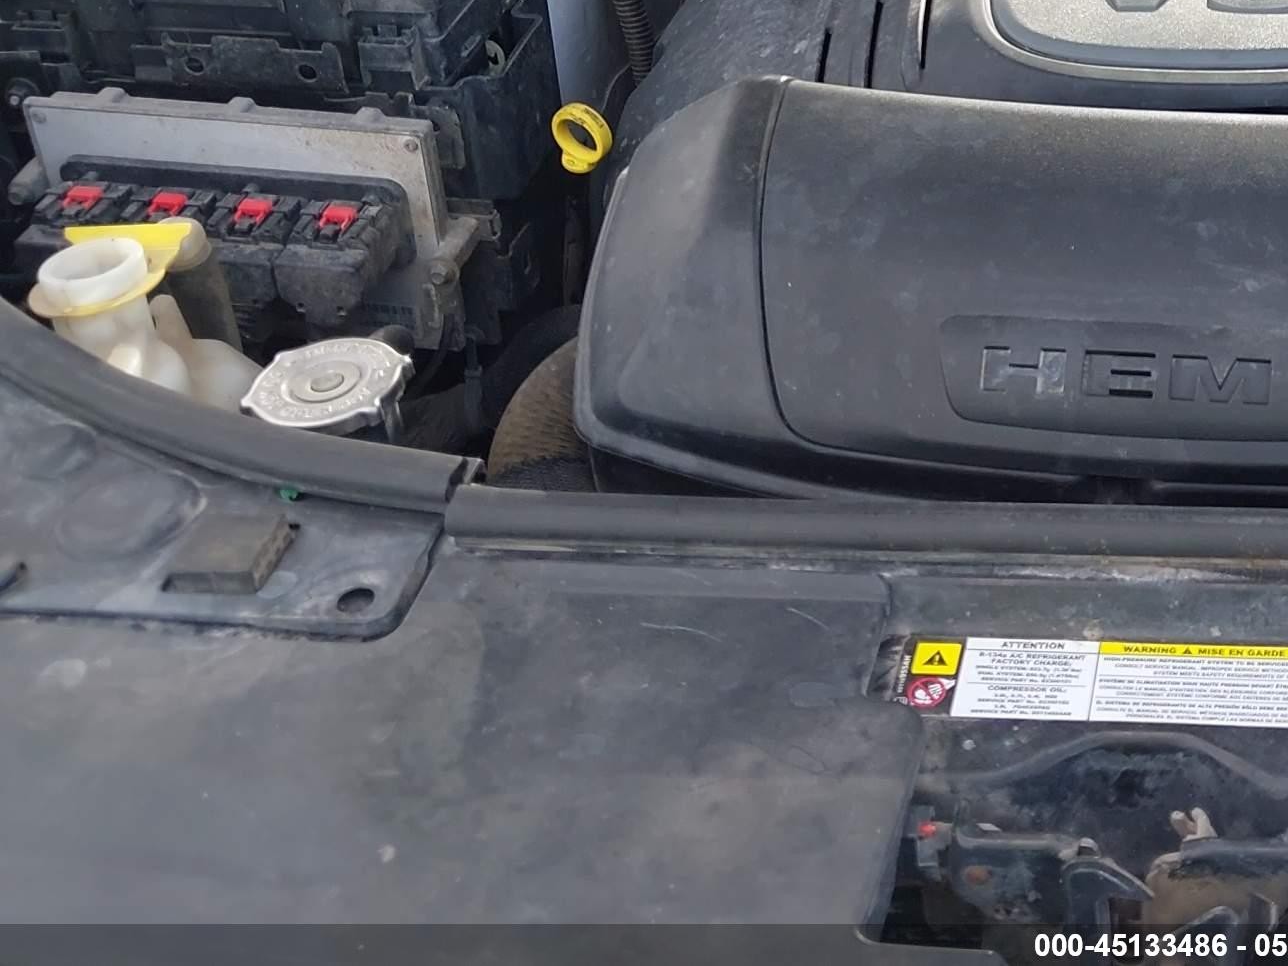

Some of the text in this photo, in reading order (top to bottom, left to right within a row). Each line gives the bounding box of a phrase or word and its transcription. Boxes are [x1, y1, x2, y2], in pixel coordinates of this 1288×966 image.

[1001, 641, 1066, 650] ATTENTION
[1123, 645, 1177, 654] WARNING
[1198, 647, 1225, 656] MISE
[1229, 648, 1244, 656] EN
[1247, 648, 1286, 657] GARDE
[1026, 653, 1086, 661] REFRIGERANT
[987, 685, 1047, 693] COMPRESSOR
